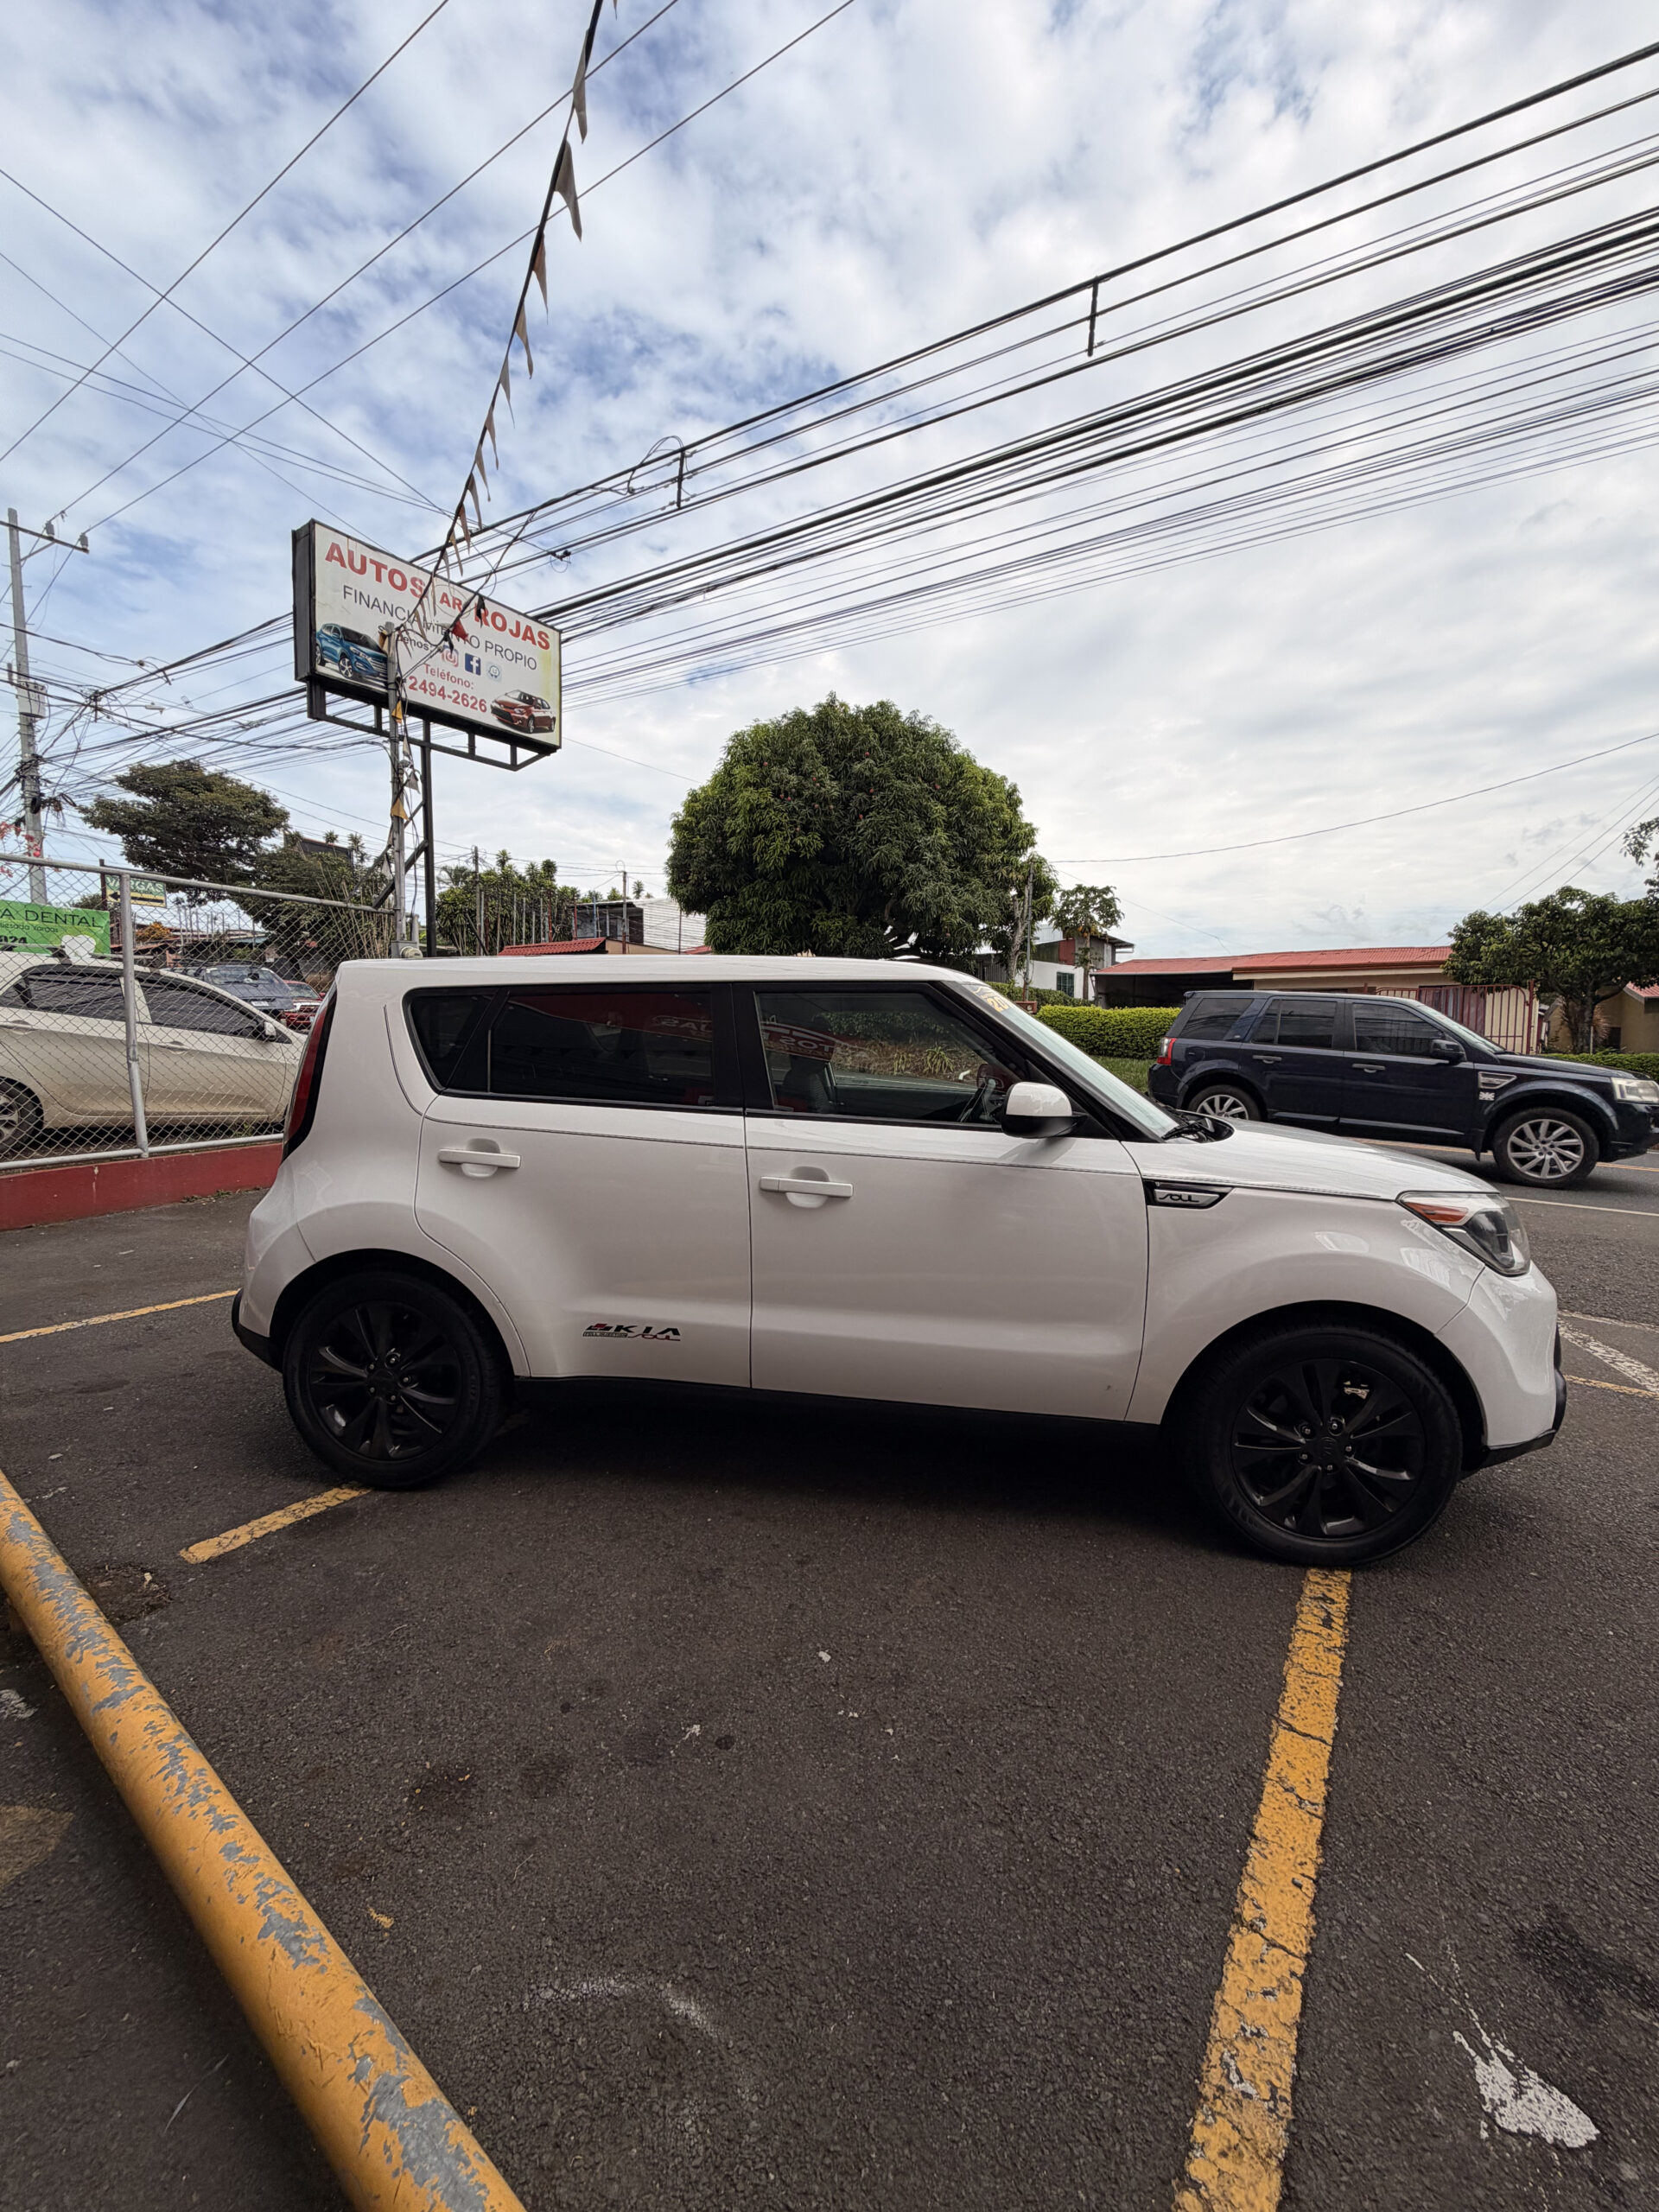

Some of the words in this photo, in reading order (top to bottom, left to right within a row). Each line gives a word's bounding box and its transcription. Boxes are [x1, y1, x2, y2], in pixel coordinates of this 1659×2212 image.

[325, 542, 425, 600] AUTOS
[474, 602, 550, 651] ROJAS
[485, 640, 537, 671] PROPIO
[423, 663, 474, 690] Teléfono:
[408, 675, 487, 714] 2494-2626
[25, 910, 103, 929] DENTAL
